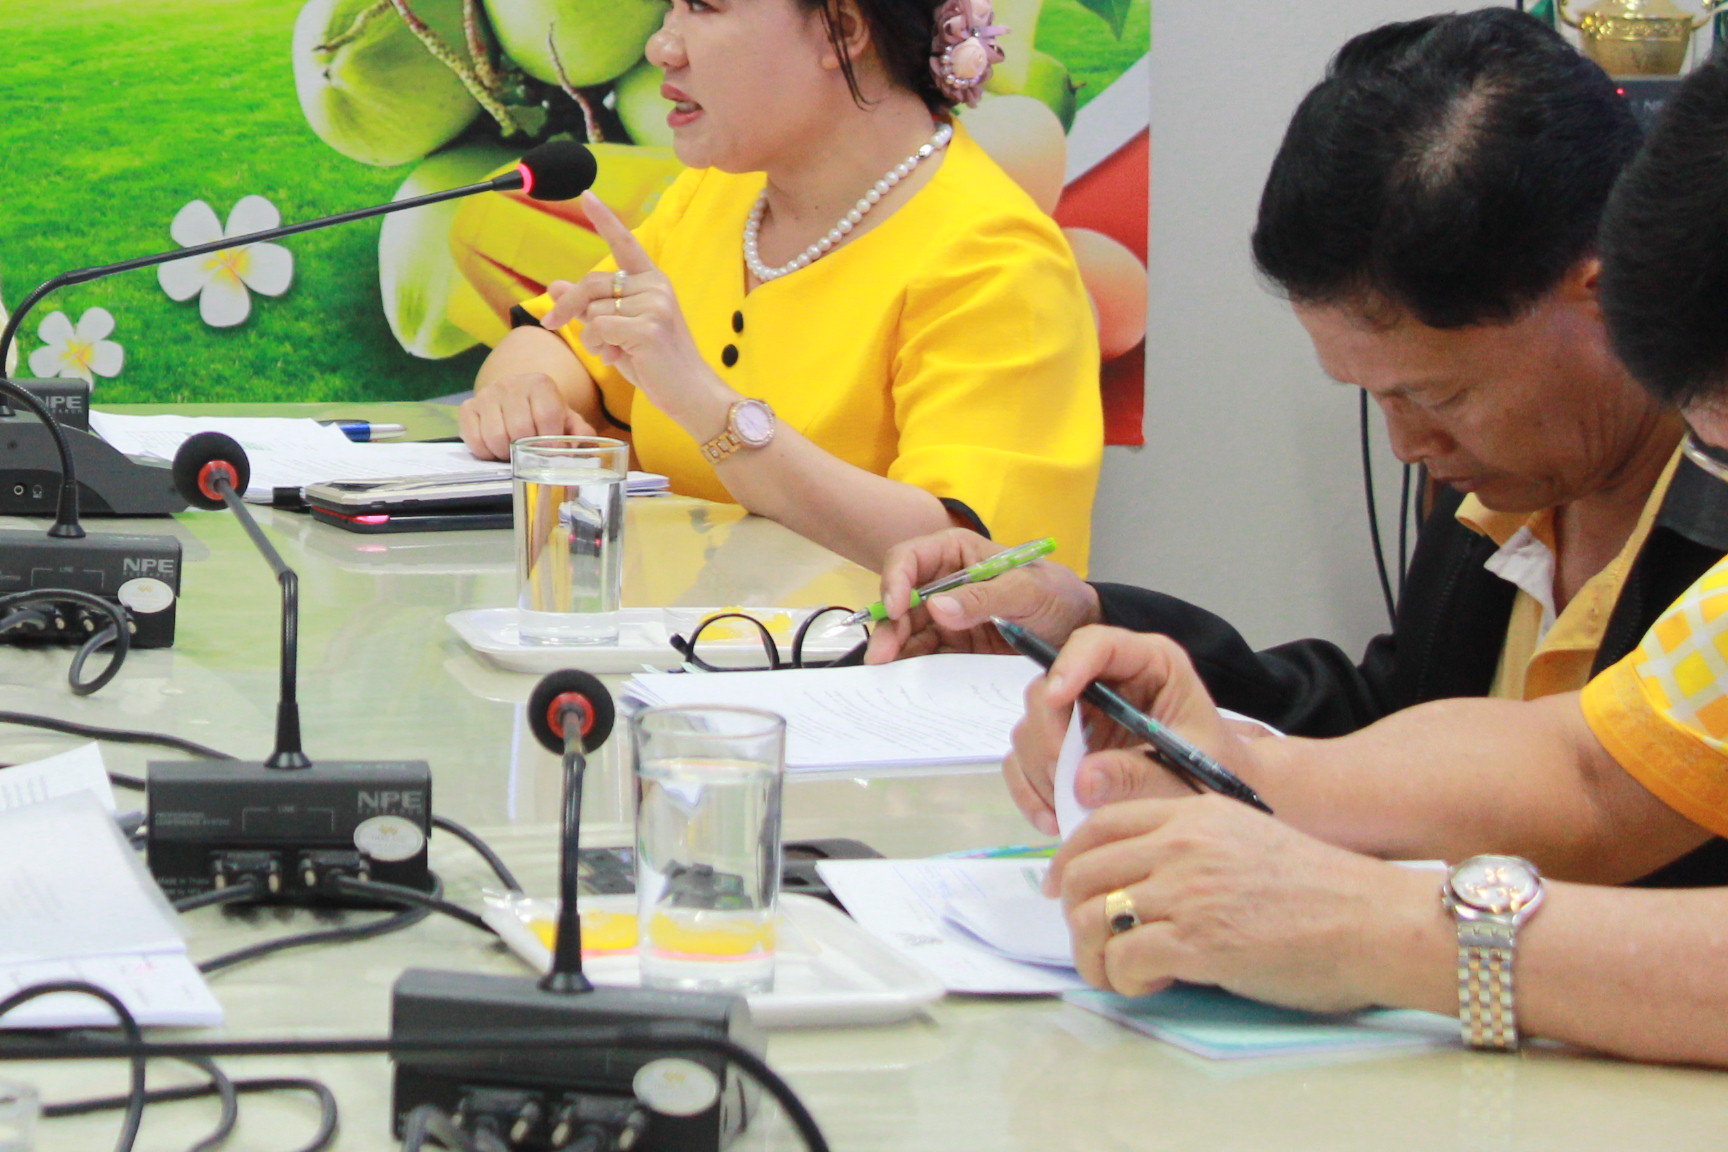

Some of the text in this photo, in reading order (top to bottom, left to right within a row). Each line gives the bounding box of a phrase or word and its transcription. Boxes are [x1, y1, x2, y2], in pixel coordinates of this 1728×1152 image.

[45, 395, 83, 409] PE
[123, 558, 174, 573] NPE
[357, 791, 422, 809] NPE
